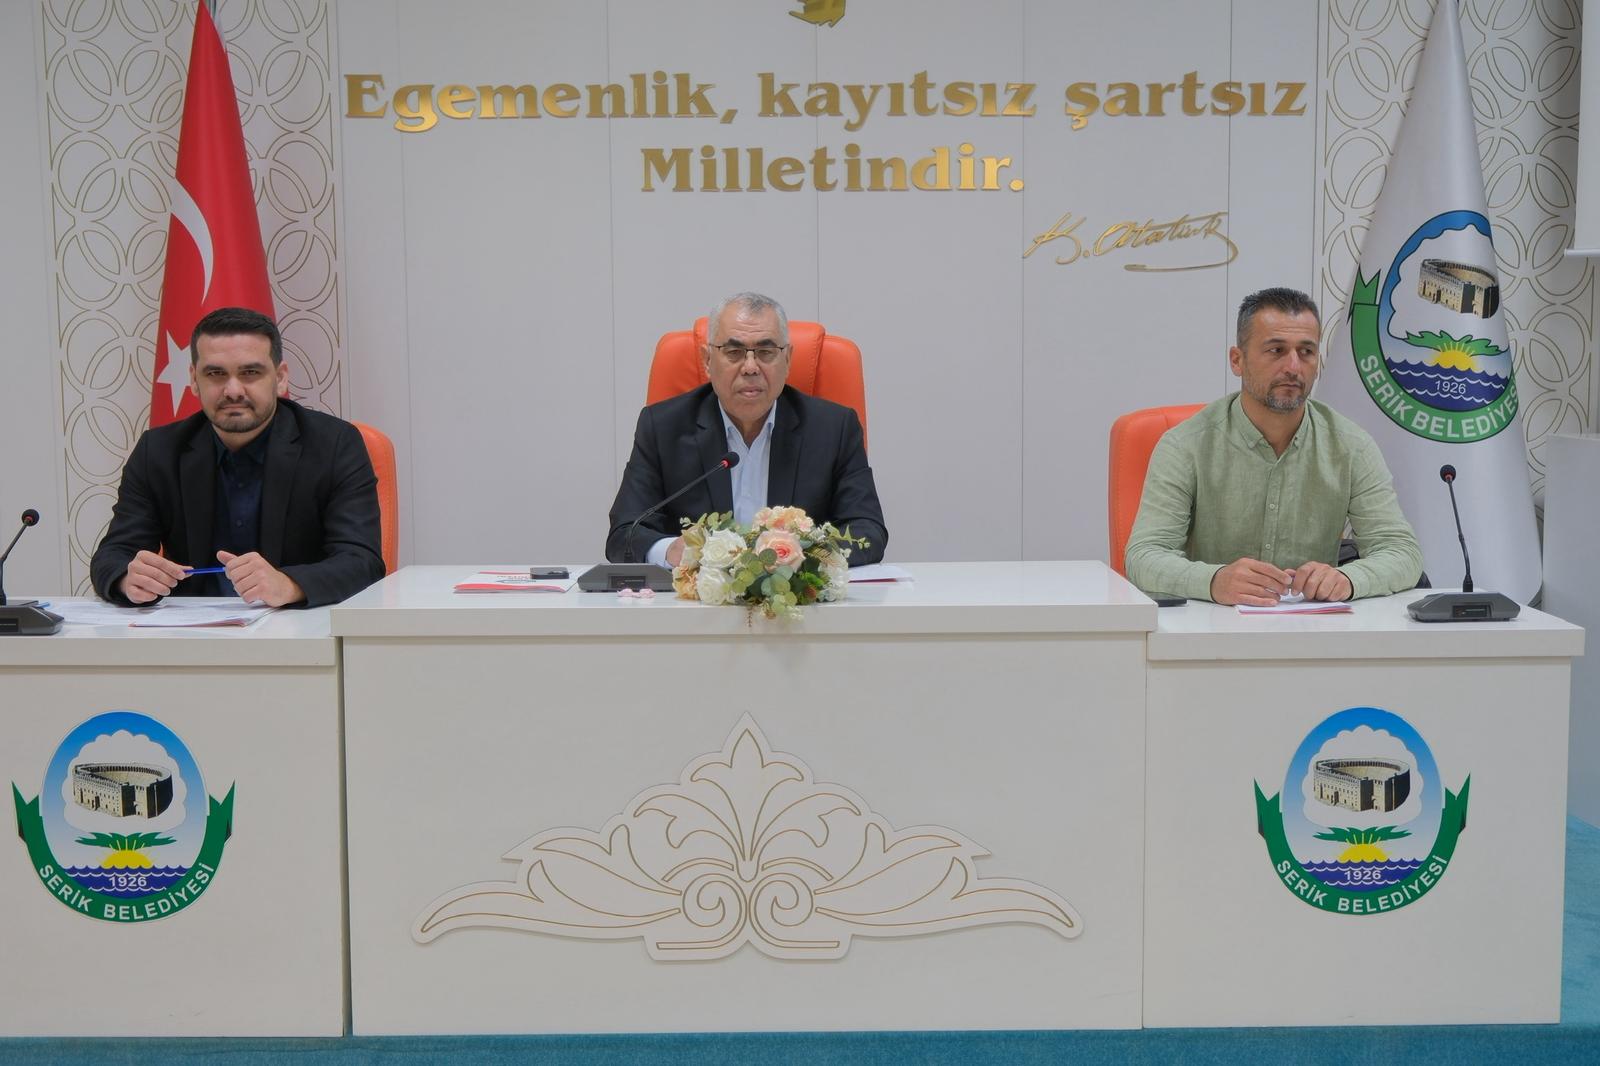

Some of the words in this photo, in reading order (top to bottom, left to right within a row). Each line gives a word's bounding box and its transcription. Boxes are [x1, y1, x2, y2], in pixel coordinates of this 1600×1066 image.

[343, 70, 738, 133] Egemenlik,
[757, 69, 1037, 132] kayıtsız
[1064, 70, 1307, 131] şartsız
[641, 142, 1024, 192] Milletindir.
[1360, 355, 1413, 422] SERİK
[1411, 385, 1518, 438] BELEDİYES
[1434, 379, 1467, 395] 1926
[39, 864, 93, 912] SERİK
[103, 863, 215, 920] BELEDİYESİ
[108, 876, 148, 888] 1926
[1277, 860, 1328, 906] SERİK
[1337, 855, 1448, 913] BELEDİYESİ
[1344, 870, 1382, 881] 1926
